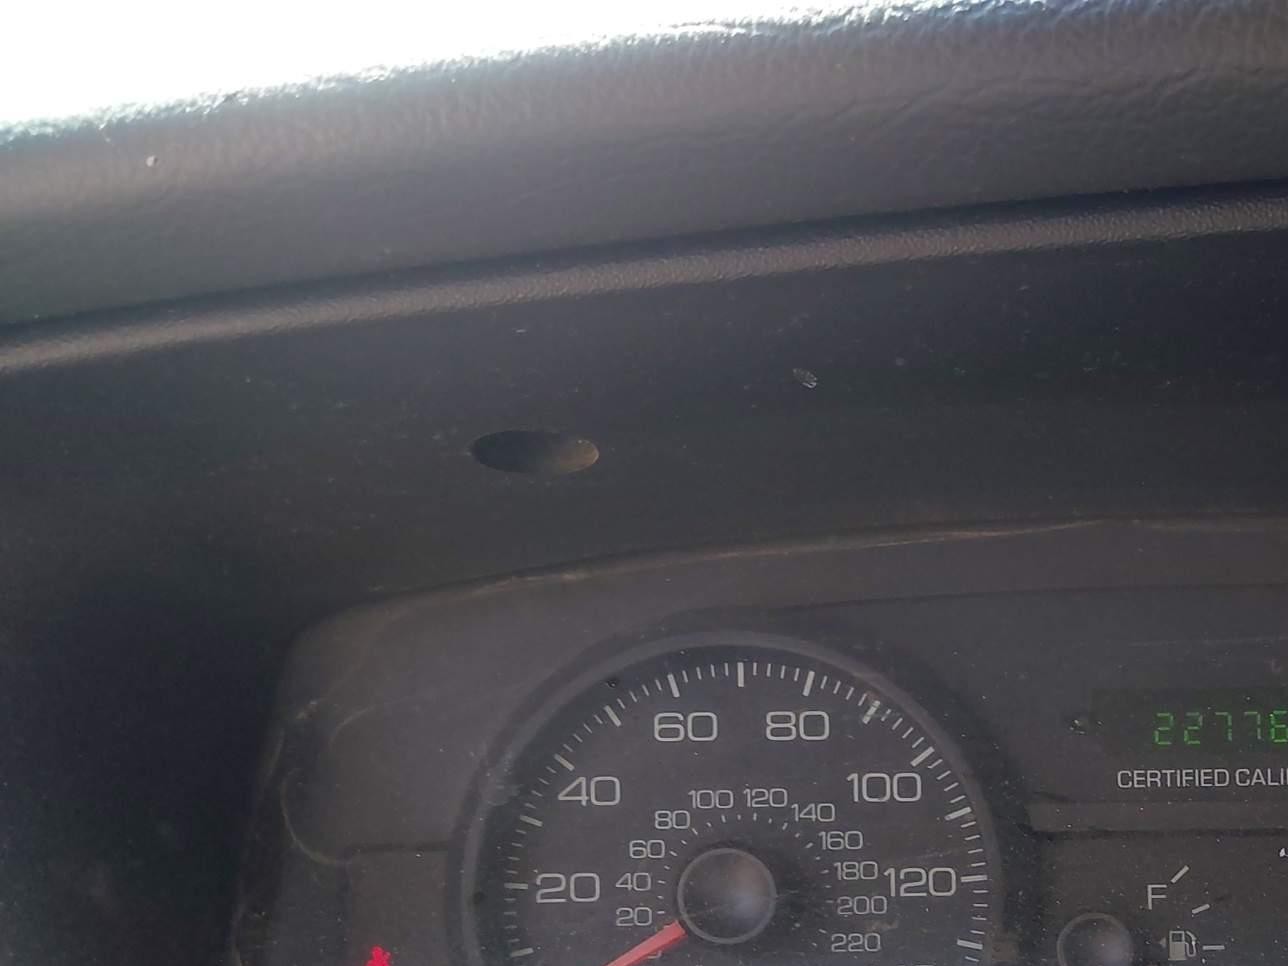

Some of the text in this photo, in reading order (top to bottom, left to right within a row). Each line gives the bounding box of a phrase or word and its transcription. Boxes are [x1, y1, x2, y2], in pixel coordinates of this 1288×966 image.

[653, 711, 718, 742] 60
[765, 711, 830, 741] 80
[846, 772, 922, 803] 100
[1117, 769, 1229, 788] CERTIFIED
[558, 776, 621, 806] 40
[688, 790, 734, 809] 100
[743, 788, 788, 808] 120
[654, 810, 691, 829] 80
[791, 804, 835, 822] 140
[629, 840, 665, 859] 60
[819, 830, 863, 850] 160
[834, 861, 878, 880] 180
[535, 872, 600, 903] 20
[615, 873, 652, 891] 40
[883, 868, 957, 897] 120
[837, 896, 887, 915] 200
[1147, 885, 1168, 909] F
[615, 907, 652, 926] 20
[831, 933, 881, 952] 220
